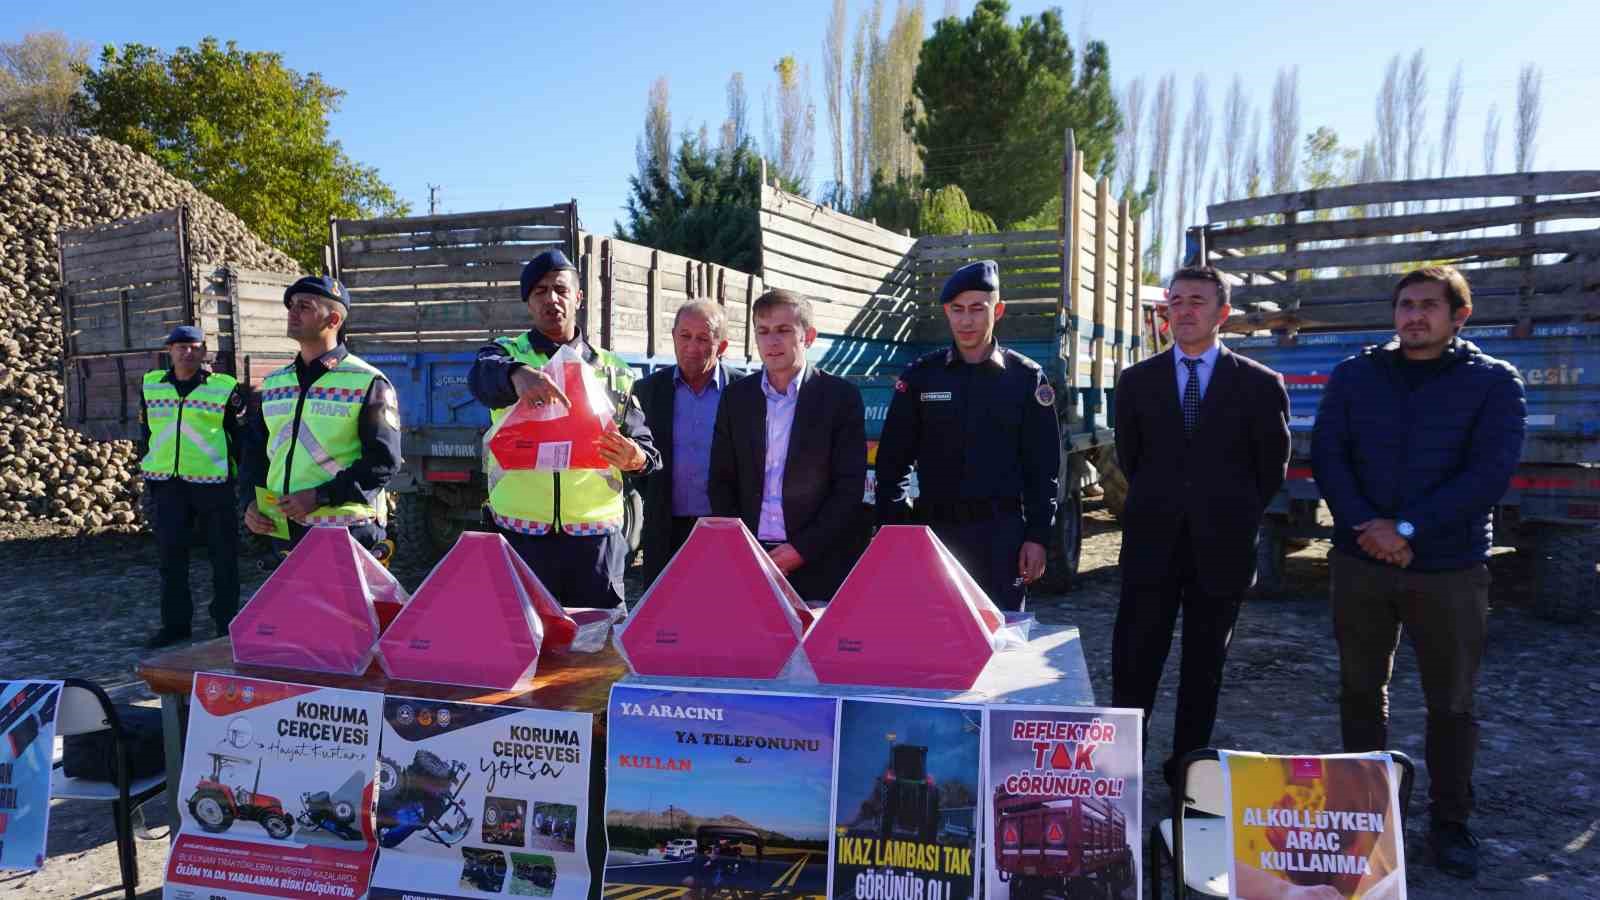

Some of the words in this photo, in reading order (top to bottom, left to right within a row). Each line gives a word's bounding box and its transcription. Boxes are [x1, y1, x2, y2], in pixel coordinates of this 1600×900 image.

[297, 701, 369, 726] KORUMA
[620, 702, 644, 716] YA
[648, 704, 724, 721] ARACINI
[510, 725, 580, 746] KORUMA
[675, 730, 698, 745] YA
[702, 732, 820, 752] TELEFONUNU
[1012, 718, 1117, 743] REFLEKTÖR
[619, 754, 692, 772] KULLAN
[1005, 770, 1092, 796] GÖRÜNÜR
[1094, 777, 1124, 798] OL!
[1243, 808, 1384, 832] ALKOLLÜYKEN
[1286, 831, 1340, 852] ARAÇ
[875, 840, 940, 872] LAMBASI
[943, 846, 972, 876] TAK
[1261, 851, 1371, 875] KULLANMA
[855, 868, 924, 900] GÖRÜNÜR
